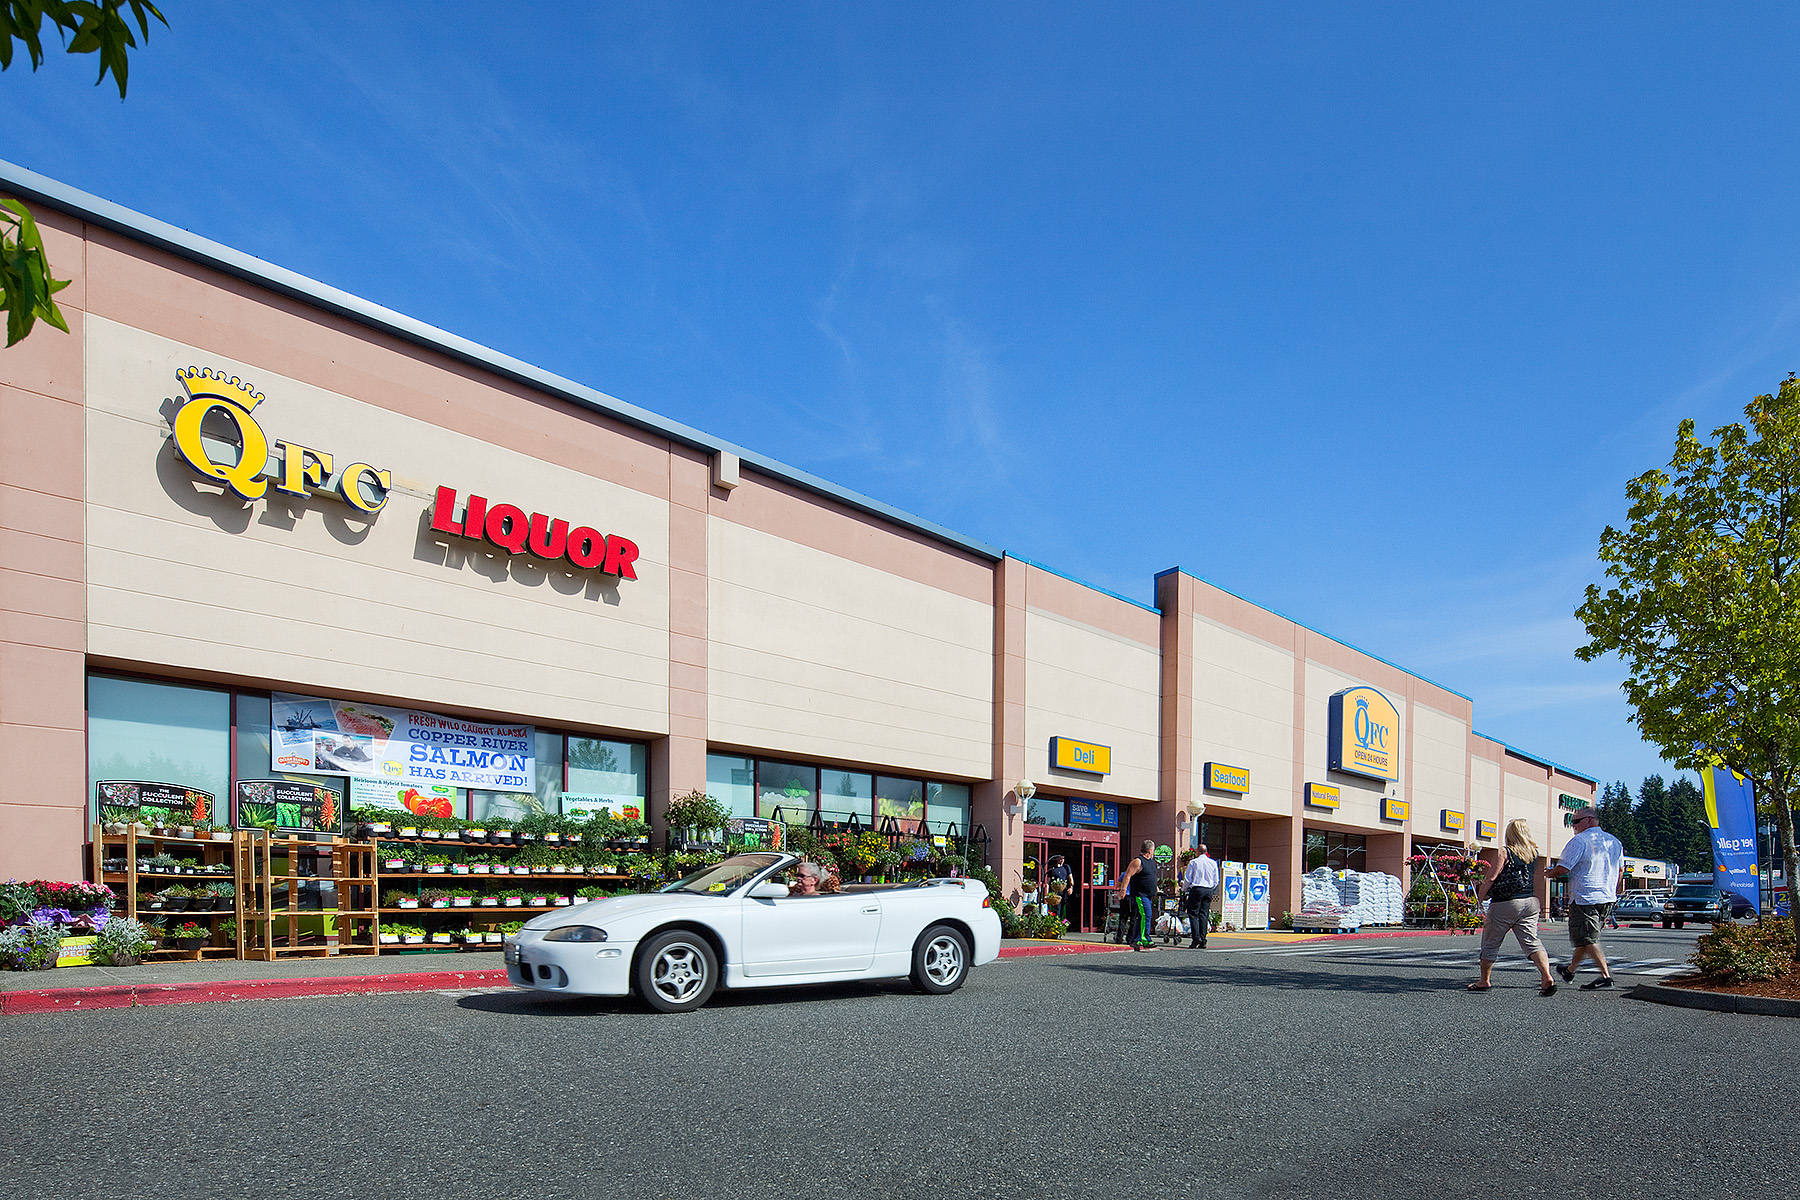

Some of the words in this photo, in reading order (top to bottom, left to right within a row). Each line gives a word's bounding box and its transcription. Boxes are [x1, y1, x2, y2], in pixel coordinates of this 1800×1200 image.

[173, 395, 392, 514] QFC
[429, 485, 640, 581] LIQUOR
[408, 713, 437, 728] FRESH
[437, 719, 460, 731] WILD
[461, 723, 495, 736] CAUGHT
[497, 727, 528, 739] ALASKA
[1355, 707, 1389, 750] QFC
[408, 728, 478, 747] COPPER
[481, 737, 528, 752] RIVER
[409, 743, 528, 772] SALMON
[1074, 747, 1095, 765] Deli
[1354, 749, 1368, 761] OPEN
[1367, 753, 1373, 762] 24
[1372, 755, 1388, 767] HOURS
[409, 766, 446, 780] HAS
[450, 770, 528, 787] ARRIVED!
[1214, 769, 1246, 787] Seafood
[141, 797, 184, 806] COLLECTION
[142, 791, 185, 801] SUCCULENT
[276, 789, 314, 798] SUCCULENT
[276, 794, 313, 803] COLLECTION
[565, 795, 593, 804] Vegetables
[1312, 790, 1326, 800] Natural
[1327, 792, 1338, 802] Foods
[1072, 804, 1089, 813] save
[1390, 803, 1404, 816] Floral
[1448, 814, 1462, 828] Bakery
